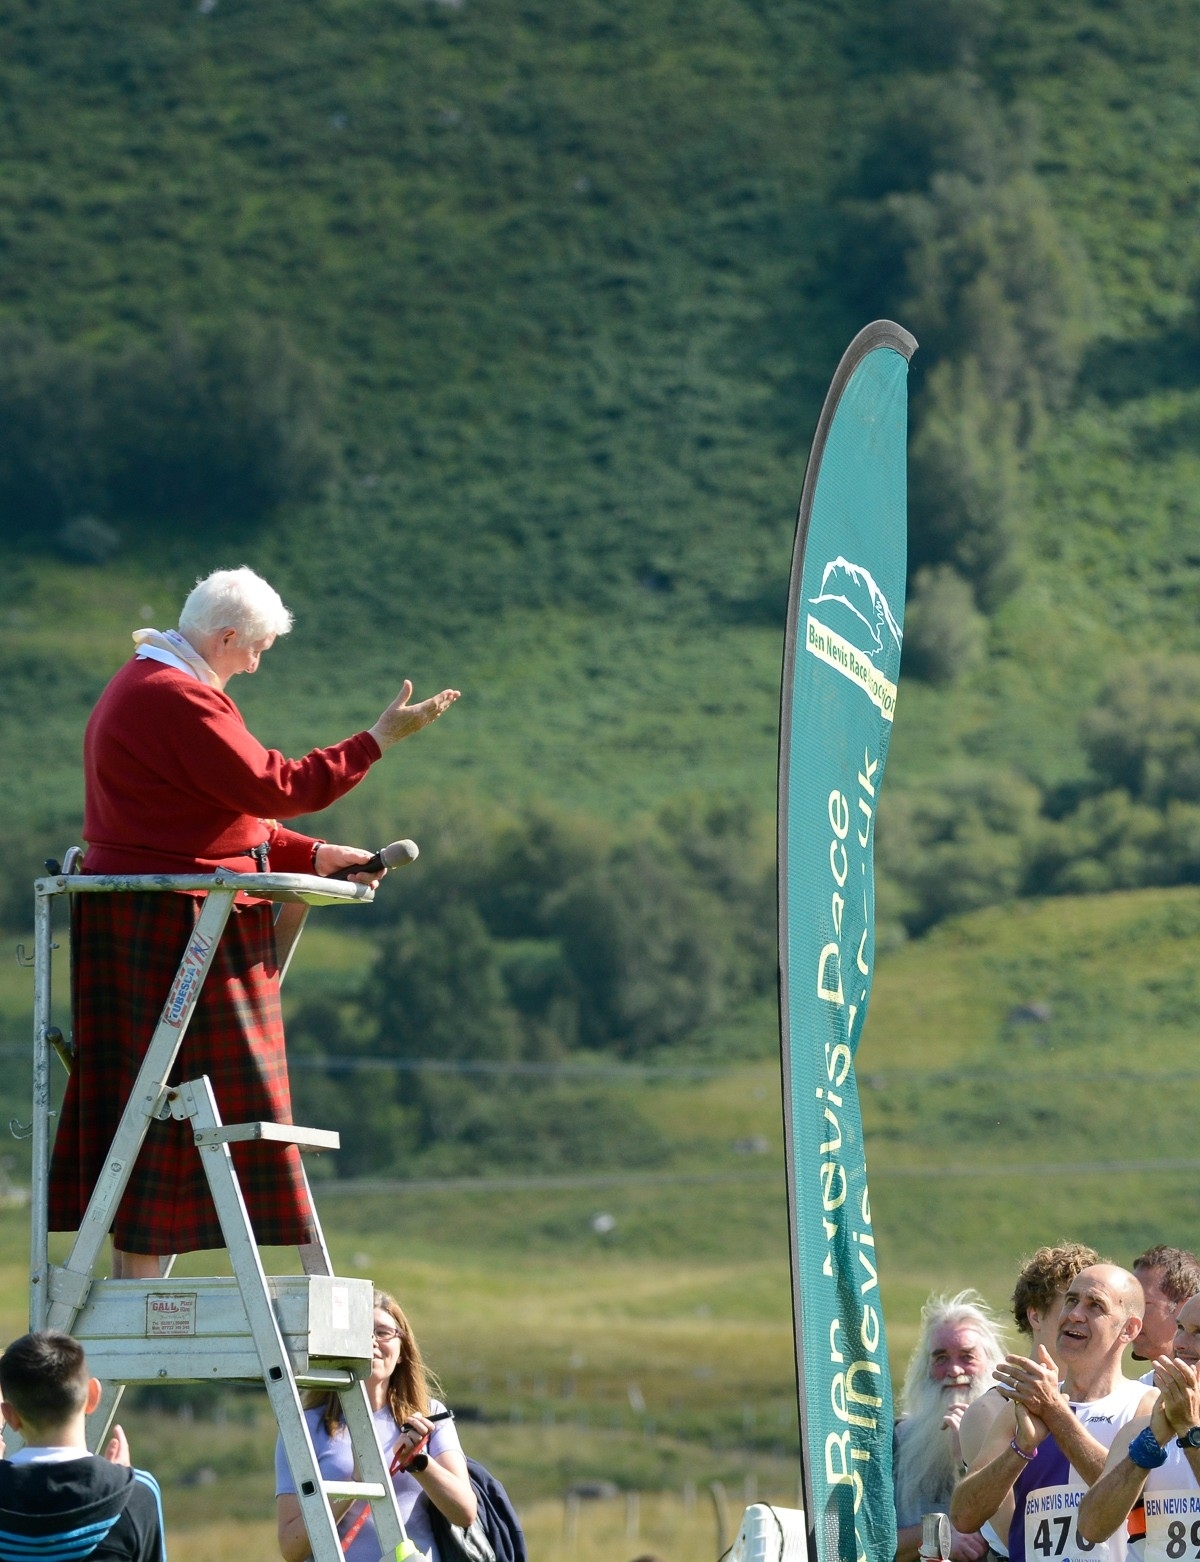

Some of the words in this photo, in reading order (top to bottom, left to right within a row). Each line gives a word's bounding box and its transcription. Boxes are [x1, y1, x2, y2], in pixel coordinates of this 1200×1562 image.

[808, 623, 825, 652] Ben
[826, 635, 848, 668] Nevis
[849, 652, 868, 683] Race
[152, 1302, 177, 1311] GALL
[1027, 1498, 1040, 1515] BEN
[1041, 1494, 1063, 1512] NEVIS
[1146, 1500, 1161, 1516] BEN
[1163, 1498, 1187, 1515] NEVIS
